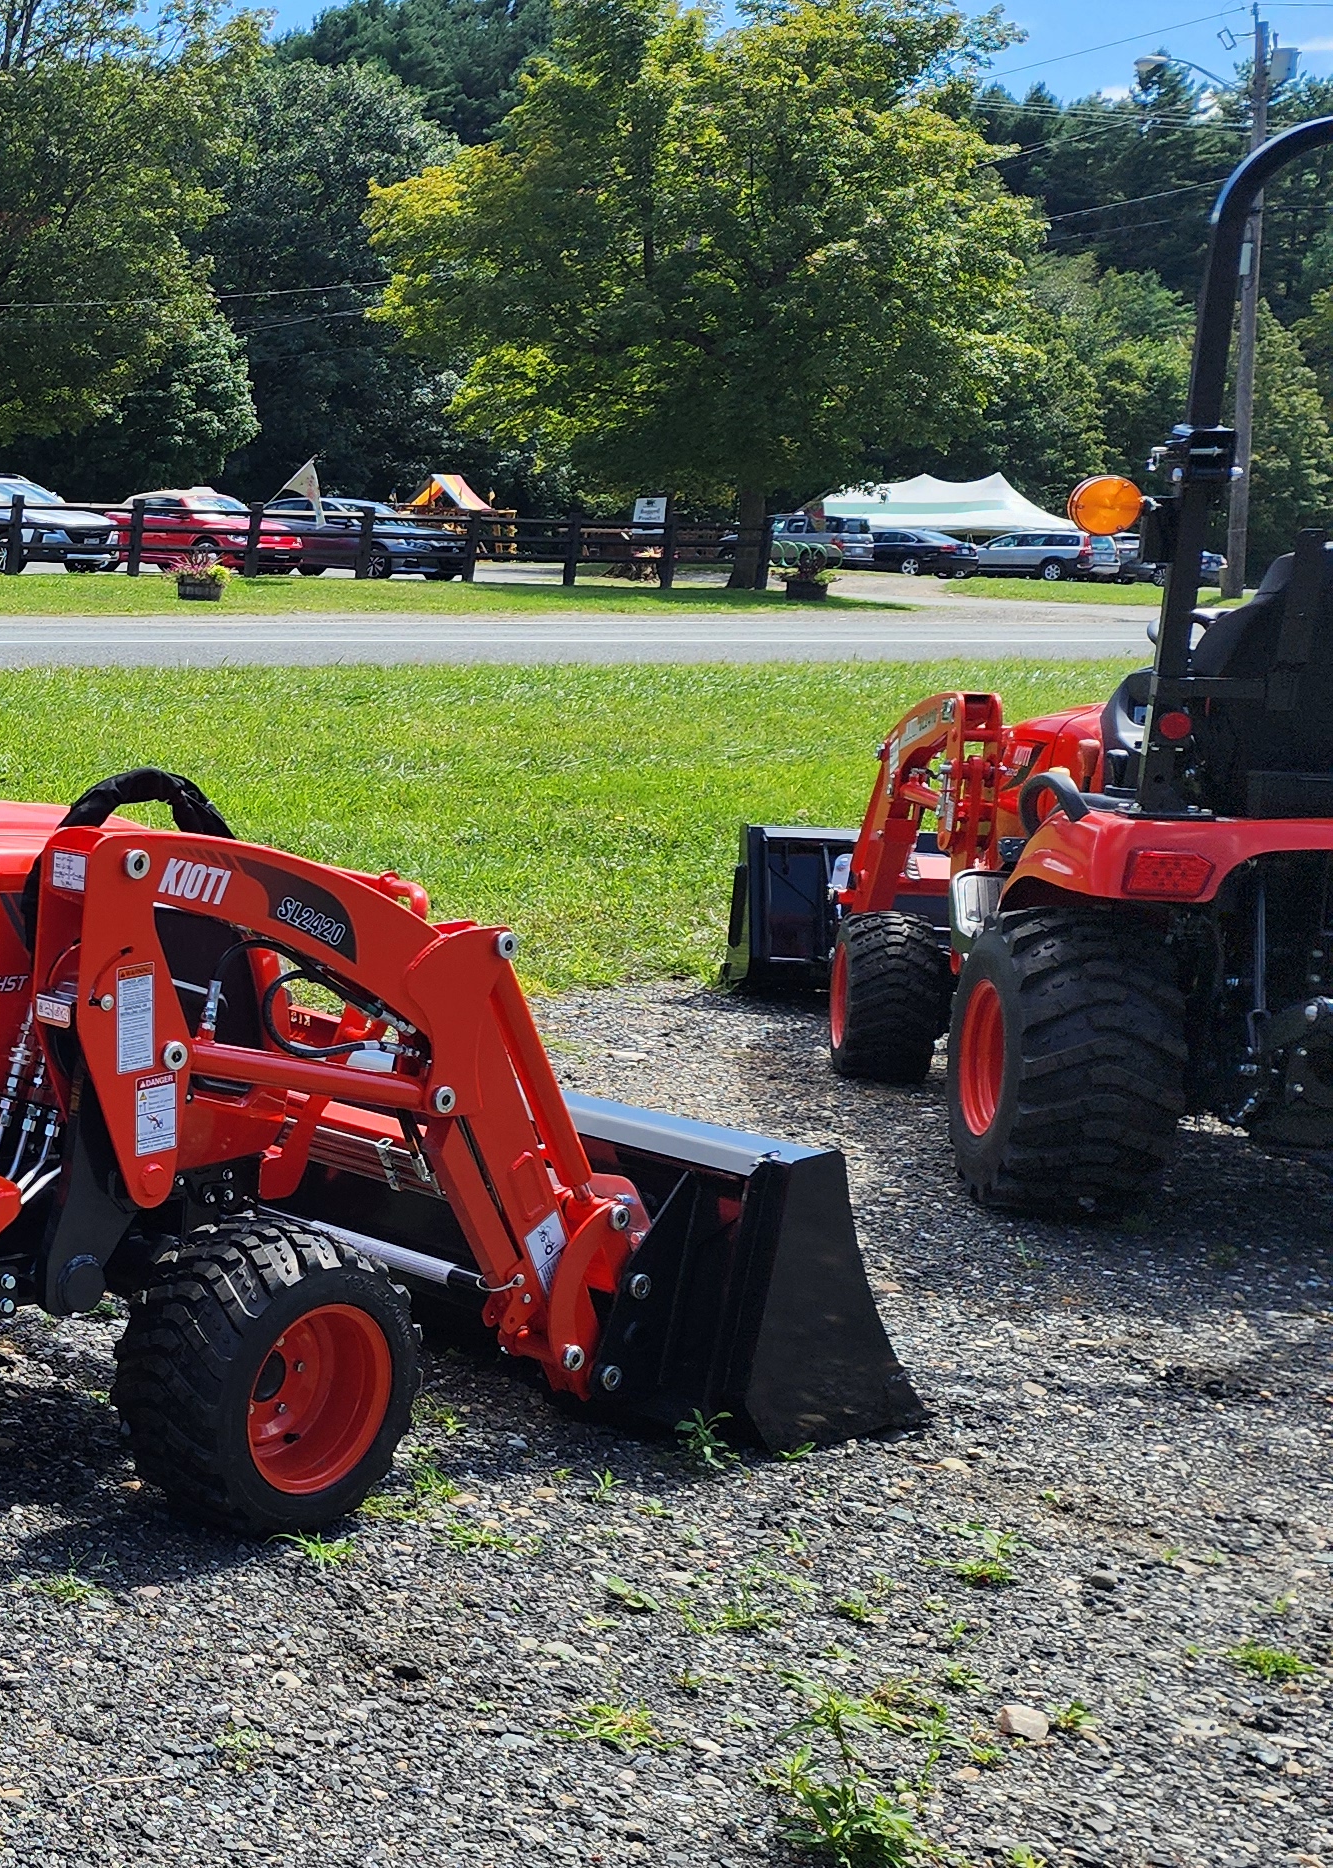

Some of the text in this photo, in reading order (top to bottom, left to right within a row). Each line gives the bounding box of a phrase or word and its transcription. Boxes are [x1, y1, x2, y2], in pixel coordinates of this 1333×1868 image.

[157, 857, 233, 905] KIOTI
[276, 896, 347, 946] SL2420
[145, 1074, 174, 1087] DANGER
